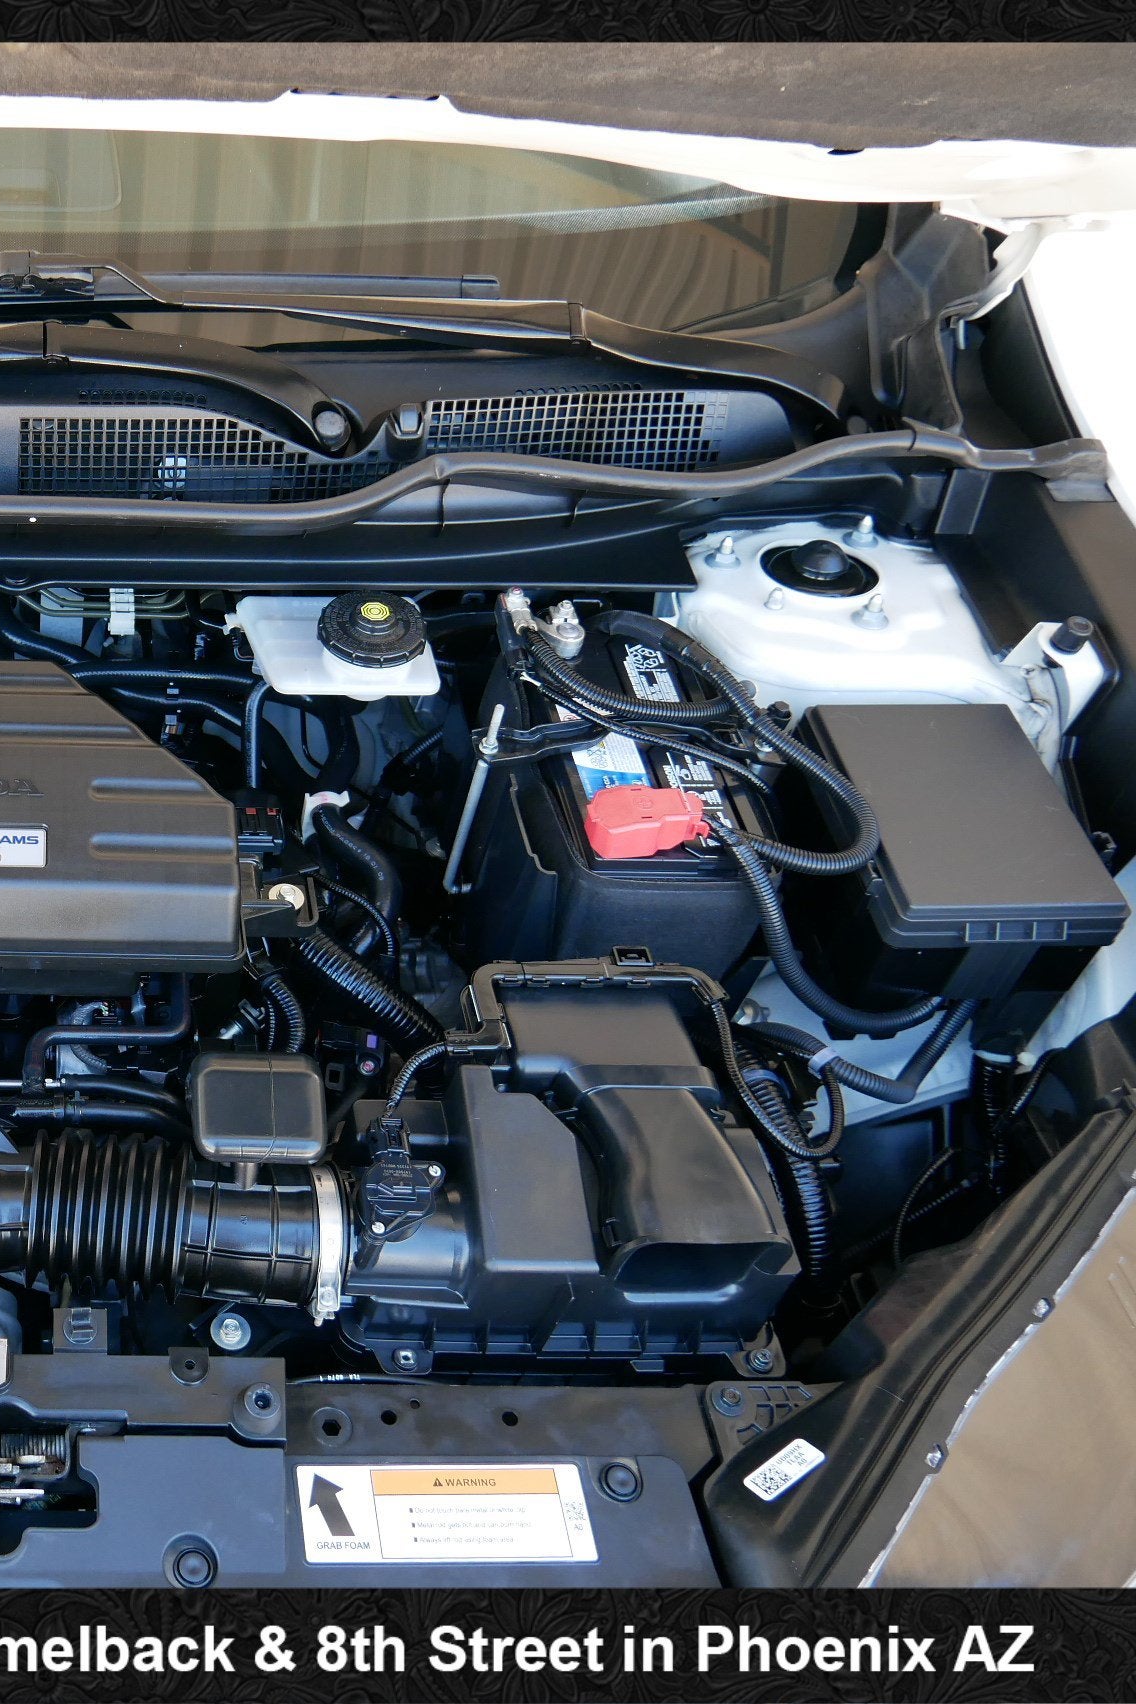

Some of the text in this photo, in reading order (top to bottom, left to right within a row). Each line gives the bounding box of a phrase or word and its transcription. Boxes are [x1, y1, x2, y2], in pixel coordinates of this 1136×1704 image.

[445, 1478, 497, 1487] WARNING
[317, 1541, 371, 1550] GRAB FOAM
